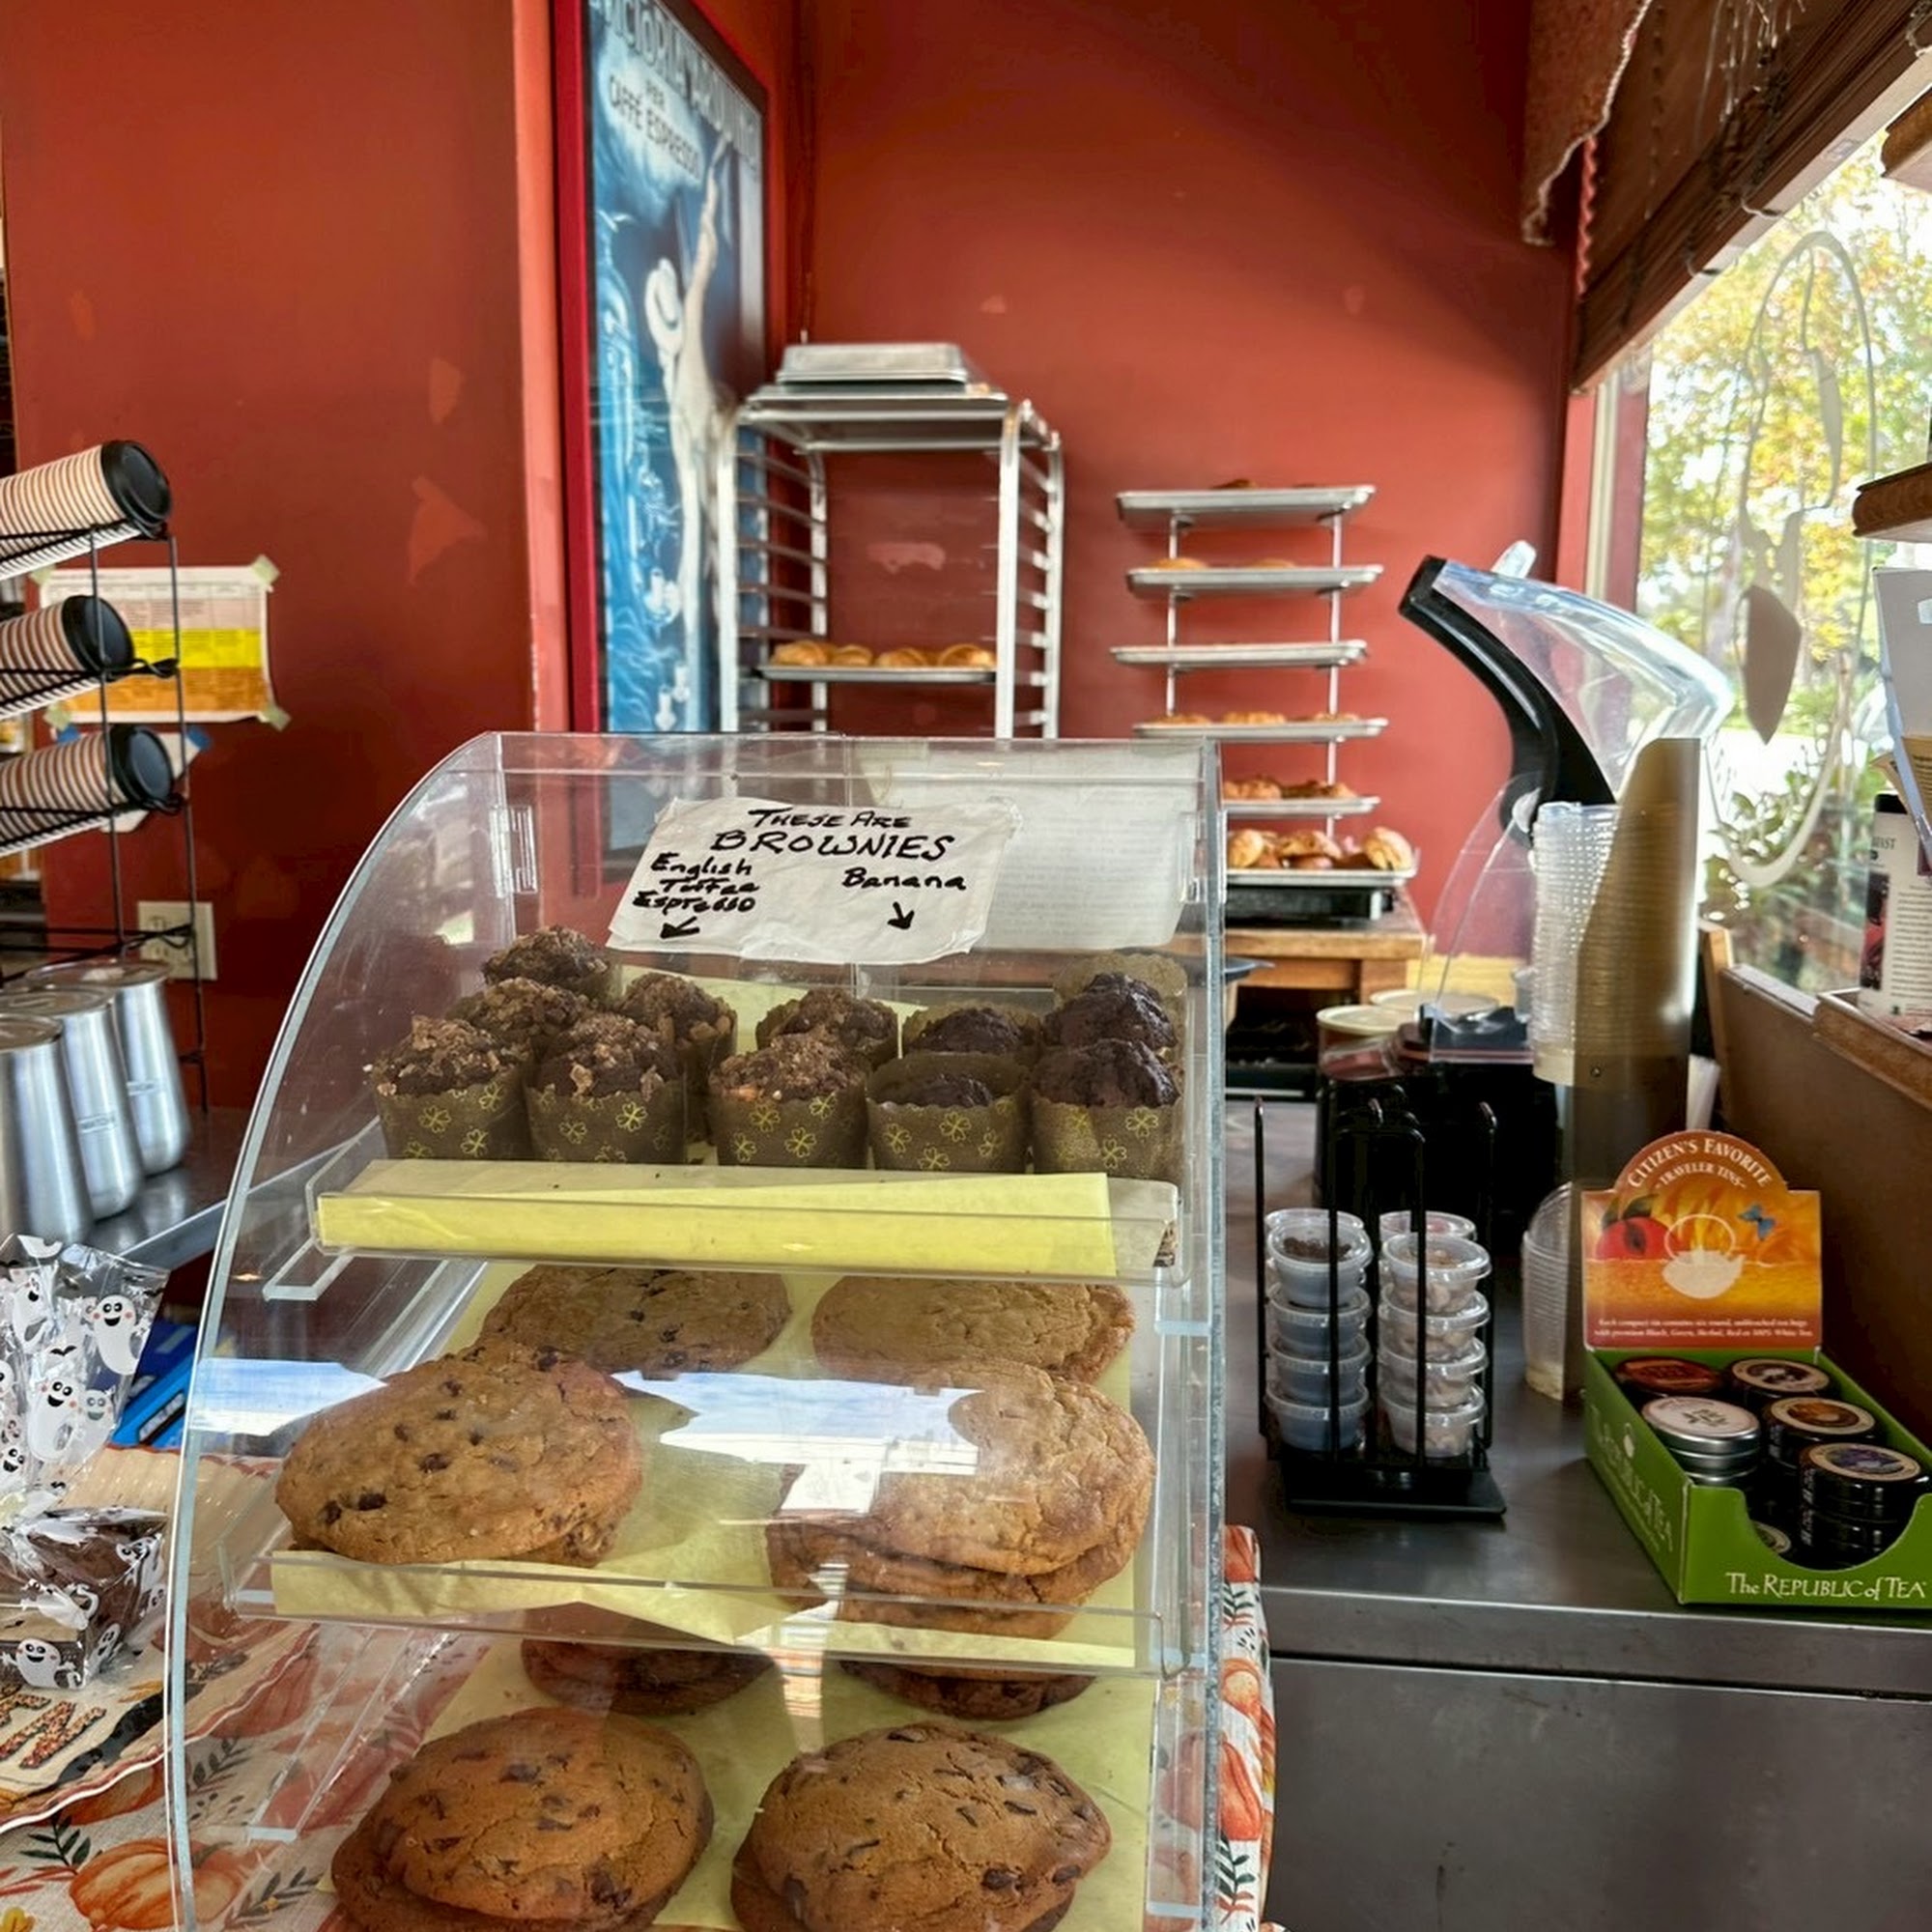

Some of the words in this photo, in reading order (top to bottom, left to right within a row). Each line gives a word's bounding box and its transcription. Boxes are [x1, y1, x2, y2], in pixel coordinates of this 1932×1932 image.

[748, 808, 844, 828] THESE
[850, 810, 912, 829] ARE
[710, 829, 955, 861] BROWNIES
[650, 852, 753, 880] English
[842, 867, 966, 891] Banana
[633, 890, 755, 916] Espresso
[1628, 1139, 1698, 1188] CITIZEN'S
[1704, 1137, 1773, 1187] FAVORITE
[1659, 1161, 1715, 1185] TRAVELER
[1717, 1165, 1740, 1186] TINS
[1725, 1572, 1760, 1594] The
[1763, 1574, 1863, 1599] REPUBLIC
[1864, 1577, 1884, 1601] of
[1885, 1577, 1925, 1599] TEA
